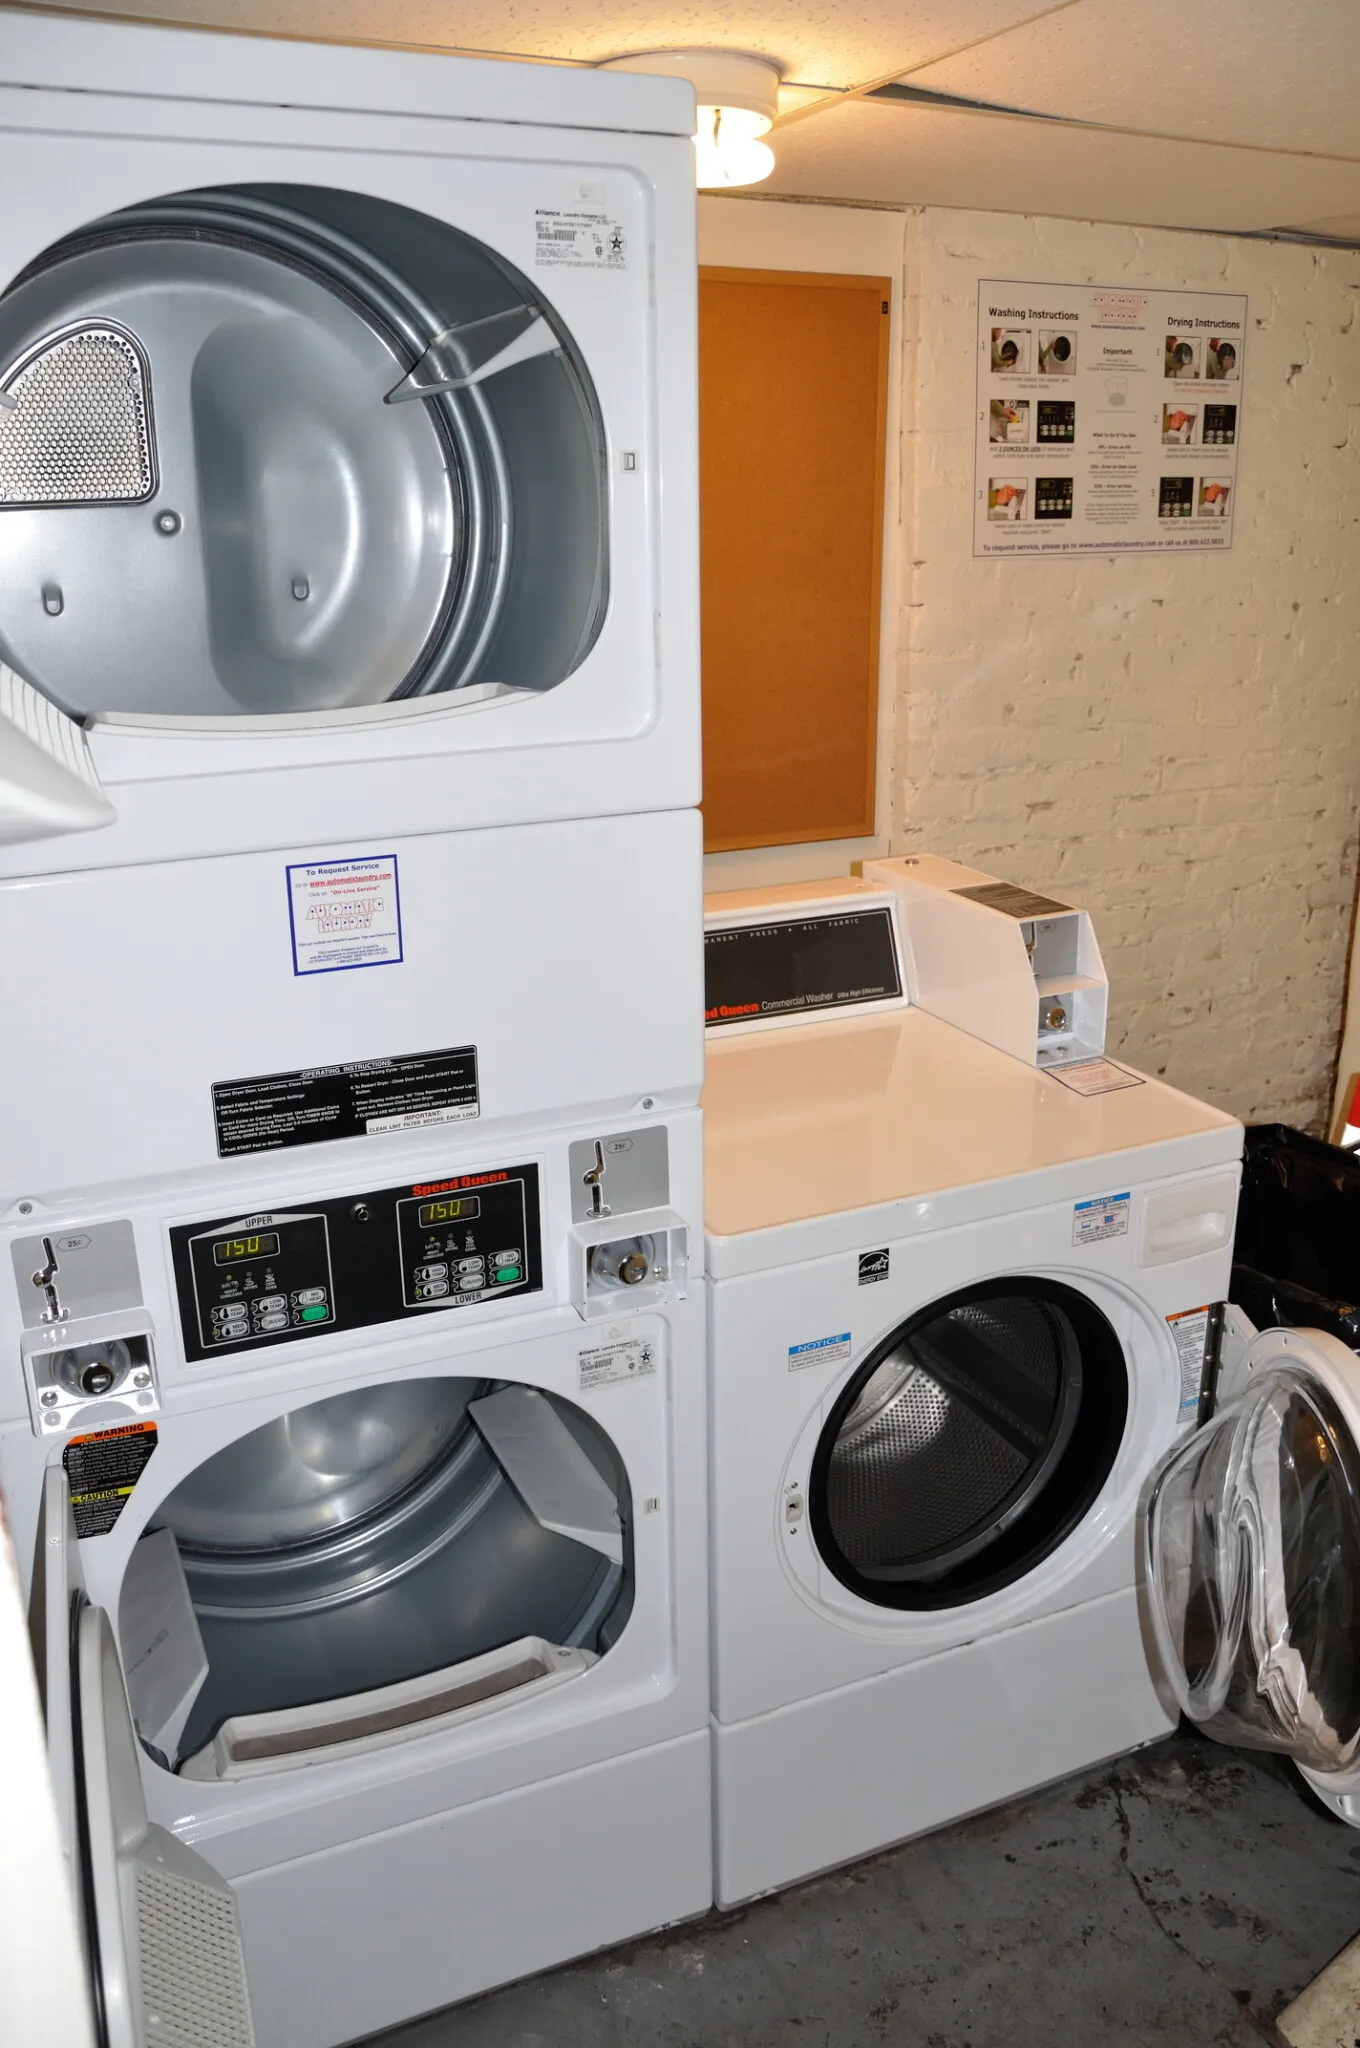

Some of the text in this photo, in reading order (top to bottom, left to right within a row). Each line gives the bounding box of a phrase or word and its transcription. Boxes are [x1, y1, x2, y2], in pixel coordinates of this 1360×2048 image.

[989, 307, 1078, 320] Washing Instructions
[1168, 317, 1240, 329] Drying Instructions
[982, 341, 985, 349] 1
[1102, 347, 1132, 357] Important
[980, 412, 984, 421] 2
[1154, 414, 1158, 424] 2
[978, 490, 983, 500] 3
[1151, 488, 1155, 498] 3
[992, 544, 1015, 552] request
[1078, 540, 1157, 548] www.automaticlaundry.com
[318, 865, 349, 876] Request
[352, 862, 379, 871] Service
[310, 873, 392, 888] www.automaticlaundry.com
[306, 897, 384, 920] AUTOMATIC
[318, 913, 374, 934] LAUNDRY
[750, 929, 778, 938] PRESS
[829, 918, 859, 927] FABRIC
[720, 1003, 760, 1017] Queen
[762, 996, 805, 1010] Commercial
[806, 991, 834, 1004] Washer
[849, 989, 861, 997] High
[862, 986, 884, 996] Efficiency
[302, 1060, 391, 1078] OPERATING INSTRUCTIONS
[404, 1110, 442, 1121] IMPORTANT:
[369, 1125, 387, 1133] CLEAN
[424, 1116, 444, 1124] BEFORE
[412, 1172, 507, 1197] Speed Queen
[246, 1216, 273, 1228] UPPER
[455, 1292, 482, 1304] LOWER
[798, 1336, 843, 1352] NOTICE
[94, 1424, 145, 1439] WARNING
[81, 1489, 119, 1501] CAUTION
